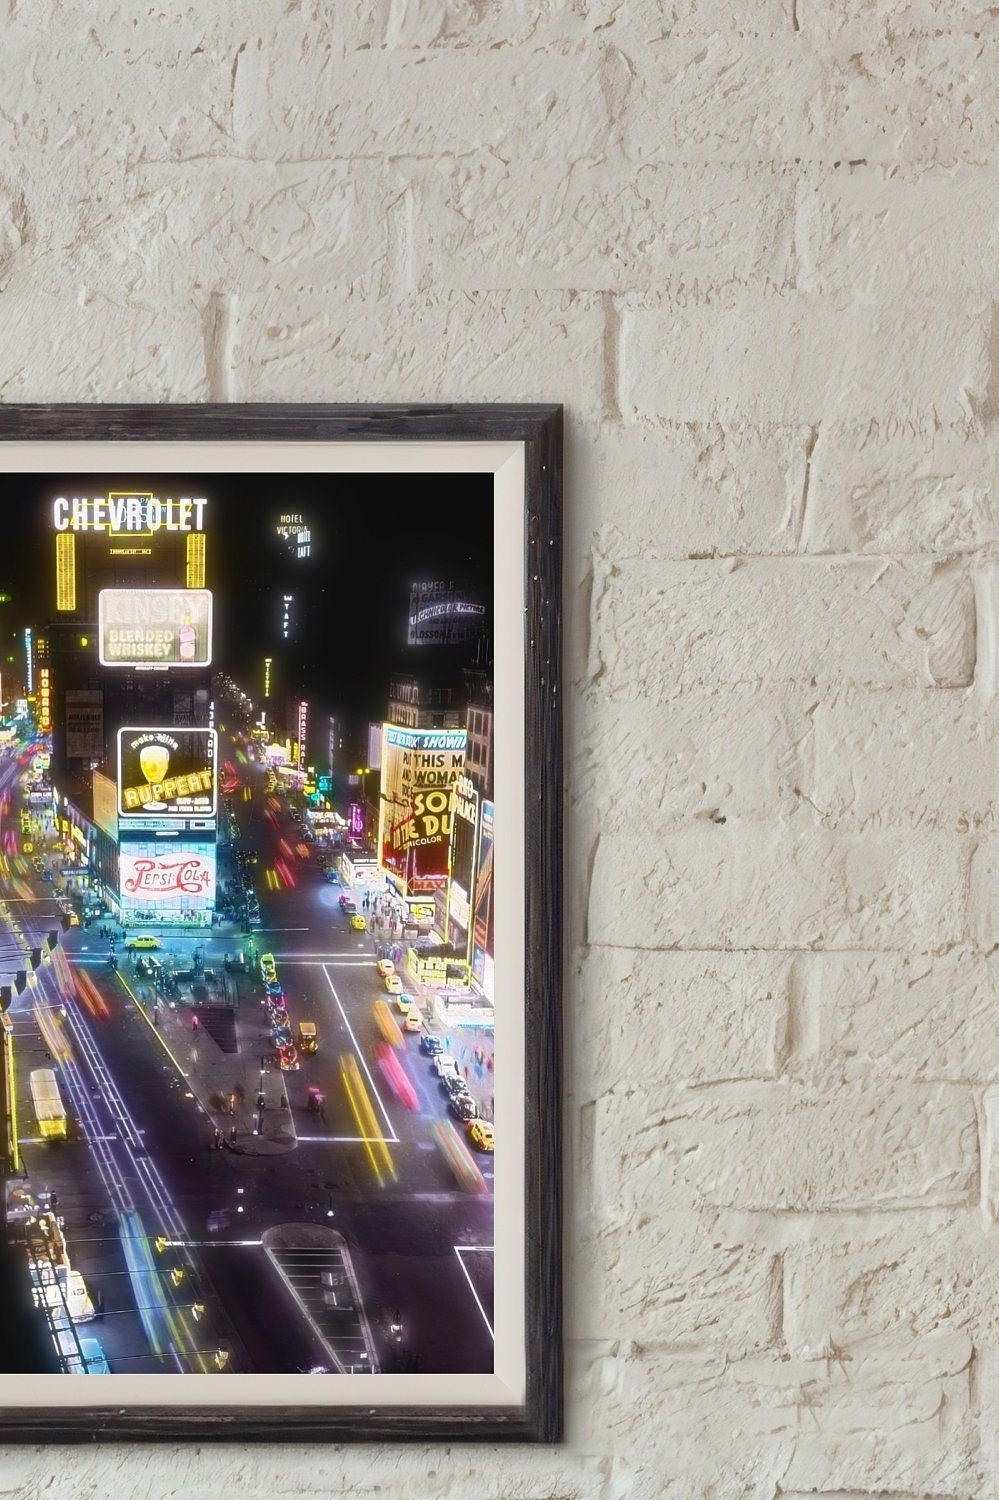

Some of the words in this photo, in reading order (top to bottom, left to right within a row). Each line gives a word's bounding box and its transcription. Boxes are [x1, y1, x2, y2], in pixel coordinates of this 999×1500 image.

[53, 497, 208, 531] CHEVROLET
[280, 514, 303, 524] HOTEL
[276, 525, 308, 535] VICTORIA
[109, 630, 174, 643] BLENDED
[109, 643, 173, 656] WHISKEY
[414, 754, 445, 768] THIS
[451, 754, 466, 768] M
